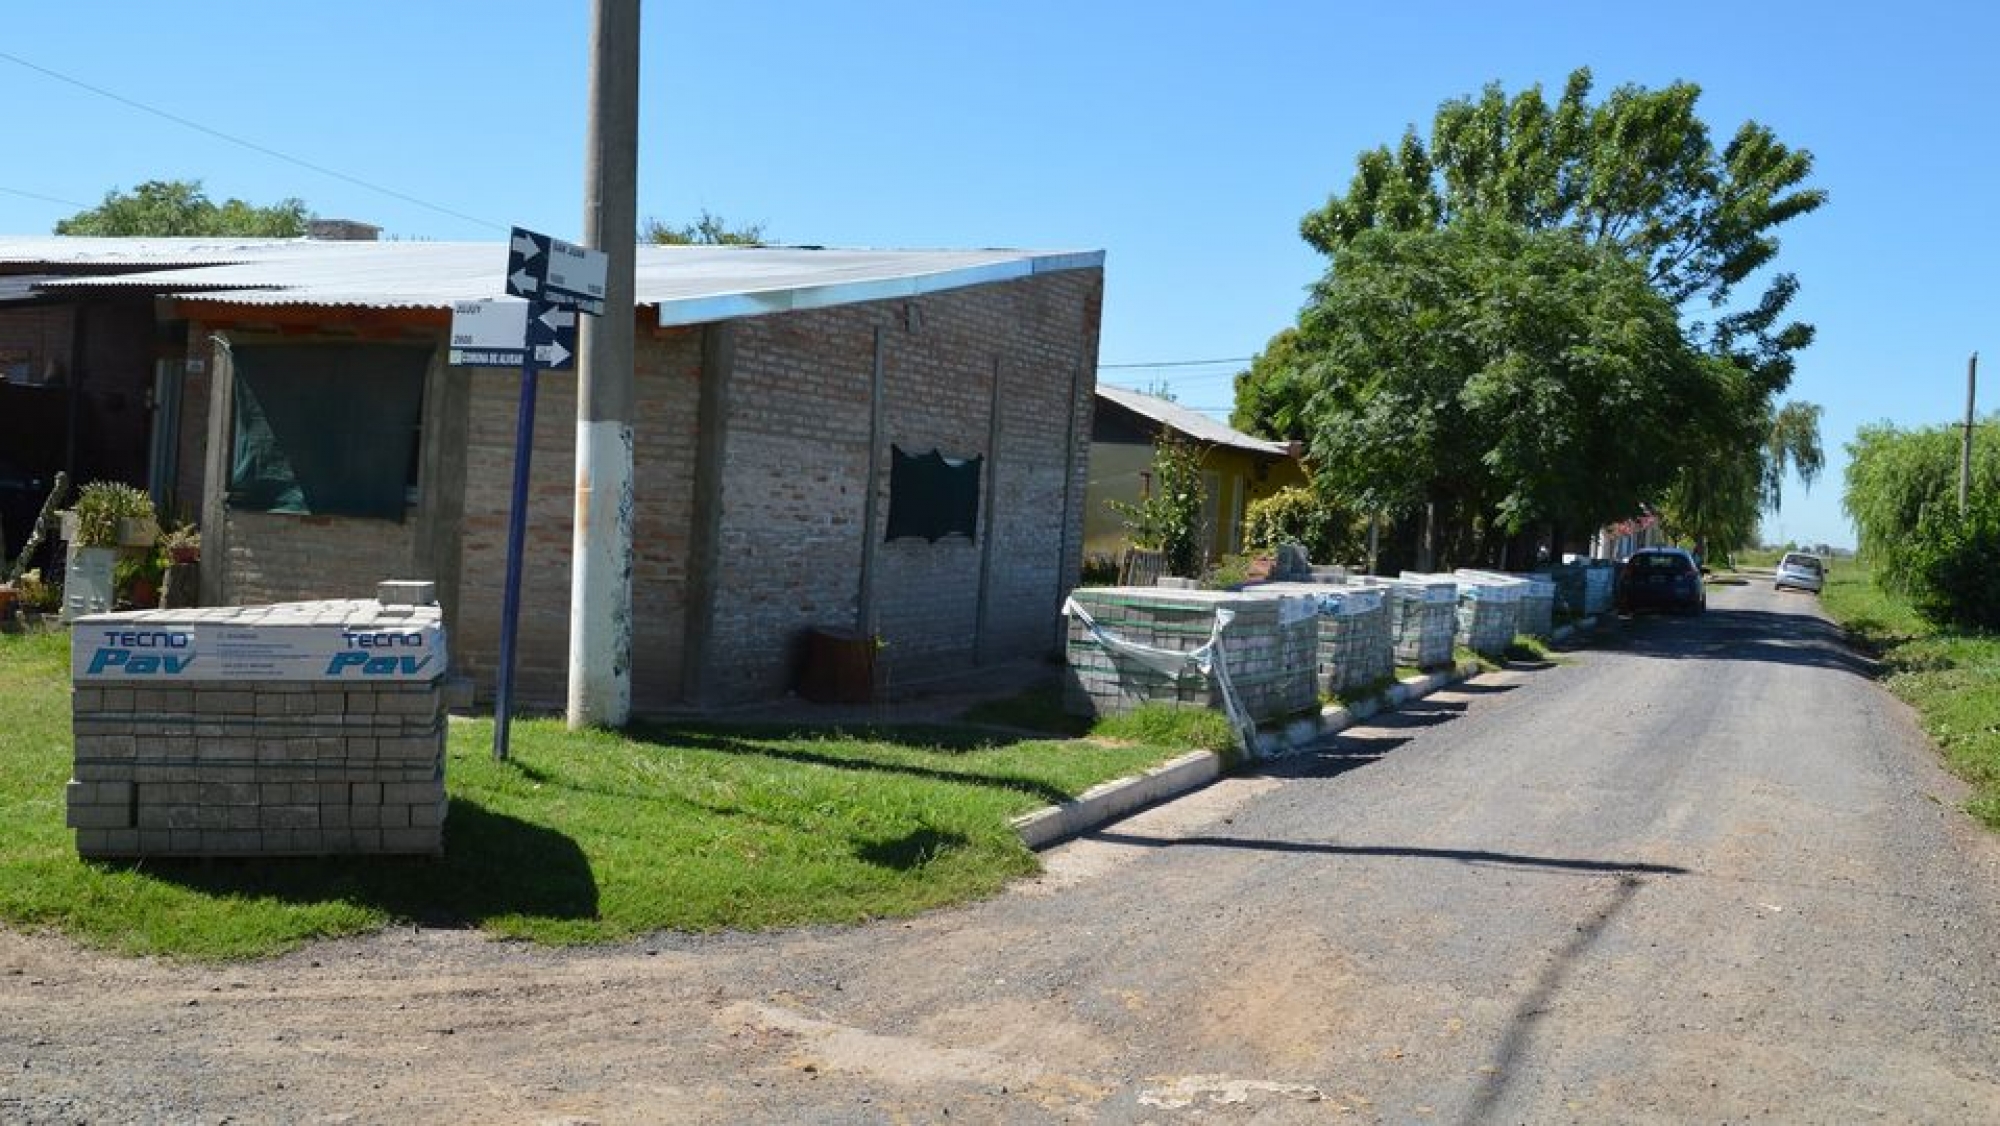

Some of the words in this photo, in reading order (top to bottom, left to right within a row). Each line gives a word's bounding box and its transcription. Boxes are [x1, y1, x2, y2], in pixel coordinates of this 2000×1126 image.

[104, 631, 188, 648] TECNO
[342, 632, 423, 648] TECNO
[86, 648, 197, 674] Pav
[326, 652, 433, 674] Pav
